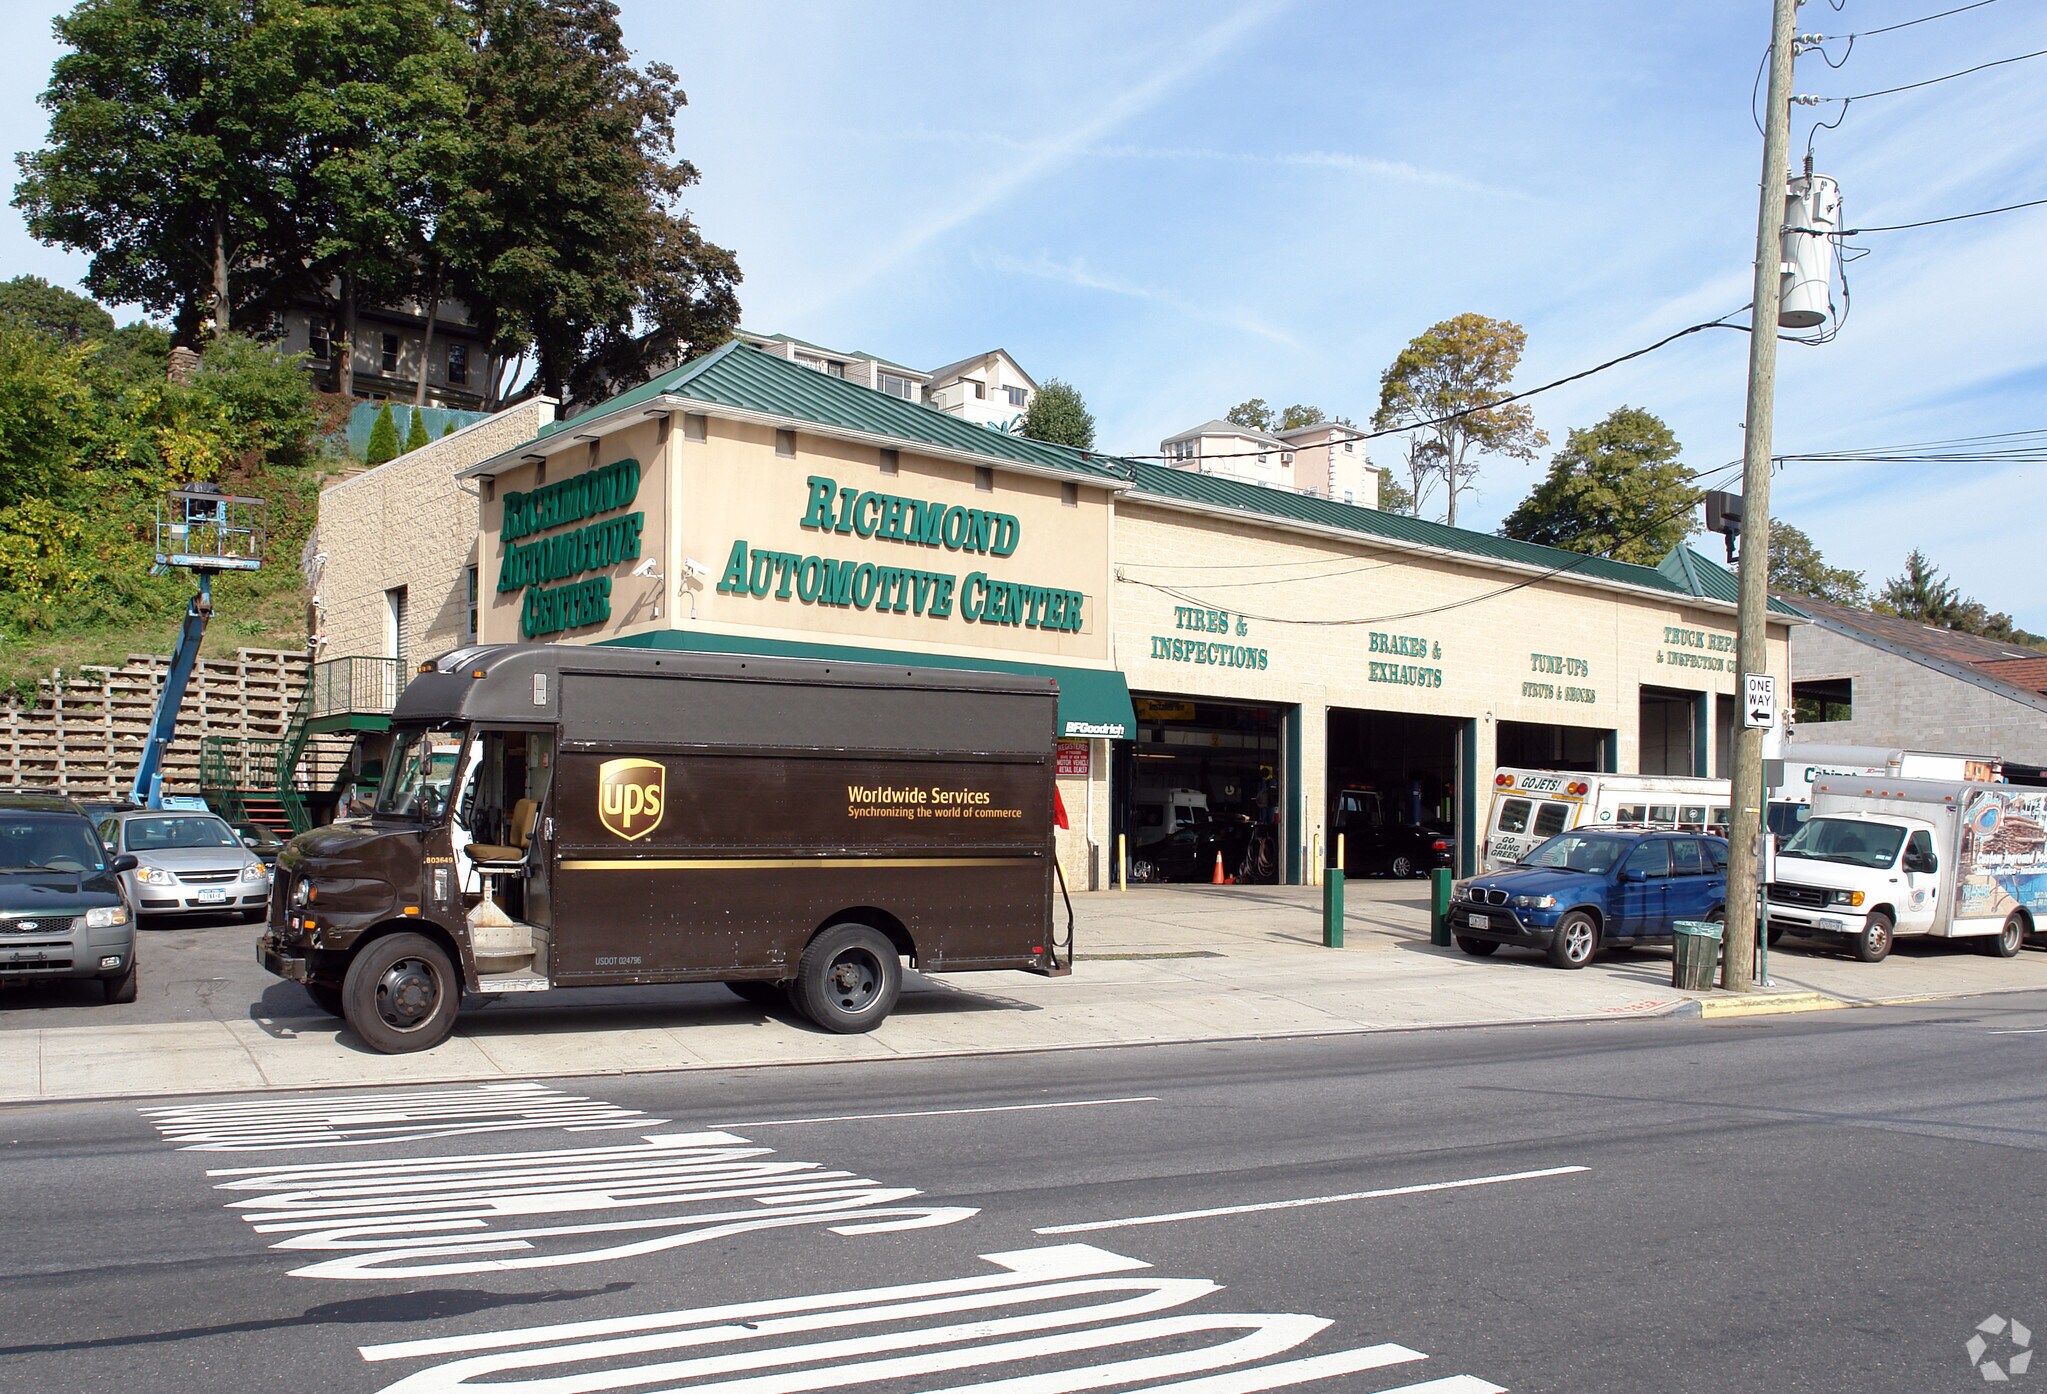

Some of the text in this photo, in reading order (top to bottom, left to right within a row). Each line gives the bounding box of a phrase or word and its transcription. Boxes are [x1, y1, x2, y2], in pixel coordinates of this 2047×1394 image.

[500, 458, 640, 542] RICHMOND
[801, 475, 1021, 558] RICHMOND
[497, 511, 645, 593] AUTOMOTIVE
[716, 540, 1084, 634] AUTOMOTIVE CENTER
[522, 576, 612, 638] CENTER
[1174, 606, 1248, 637] TIRES &
[1368, 632, 1442, 660] BRAKES &
[1663, 626, 1737, 653] TRUCK REPA
[1151, 636, 1268, 671] INSPECTIONS
[1530, 653, 1588, 678] TUNE-UPS
[1656, 649, 1664, 664] &
[1667, 650, 1725, 673] INSPECTION
[1368, 661, 1442, 688] EXHAUSTS
[1749, 679, 1771, 693] ONE
[1521, 681, 1596, 704] STRUTS & SHOCKS
[1749, 693, 1771, 707] WAY
[1065, 721, 1125, 735] BFGoodrich
[1058, 743, 1088, 752] REGISTERED
[848, 786, 990, 805] Worldwide Services
[1521, 777, 1562, 792] GO JETS!
[603, 783, 660, 828] ups
[848, 805, 1022, 820] Synchronizing the world of commerce
[1495, 842, 1520, 852] GANG
[1502, 836, 1515, 844] GO
[595, 957, 618, 966] USDOT
[136, 1082, 672, 1151] SCHOOL
[205, 1131, 979, 1280] SCHOOL
